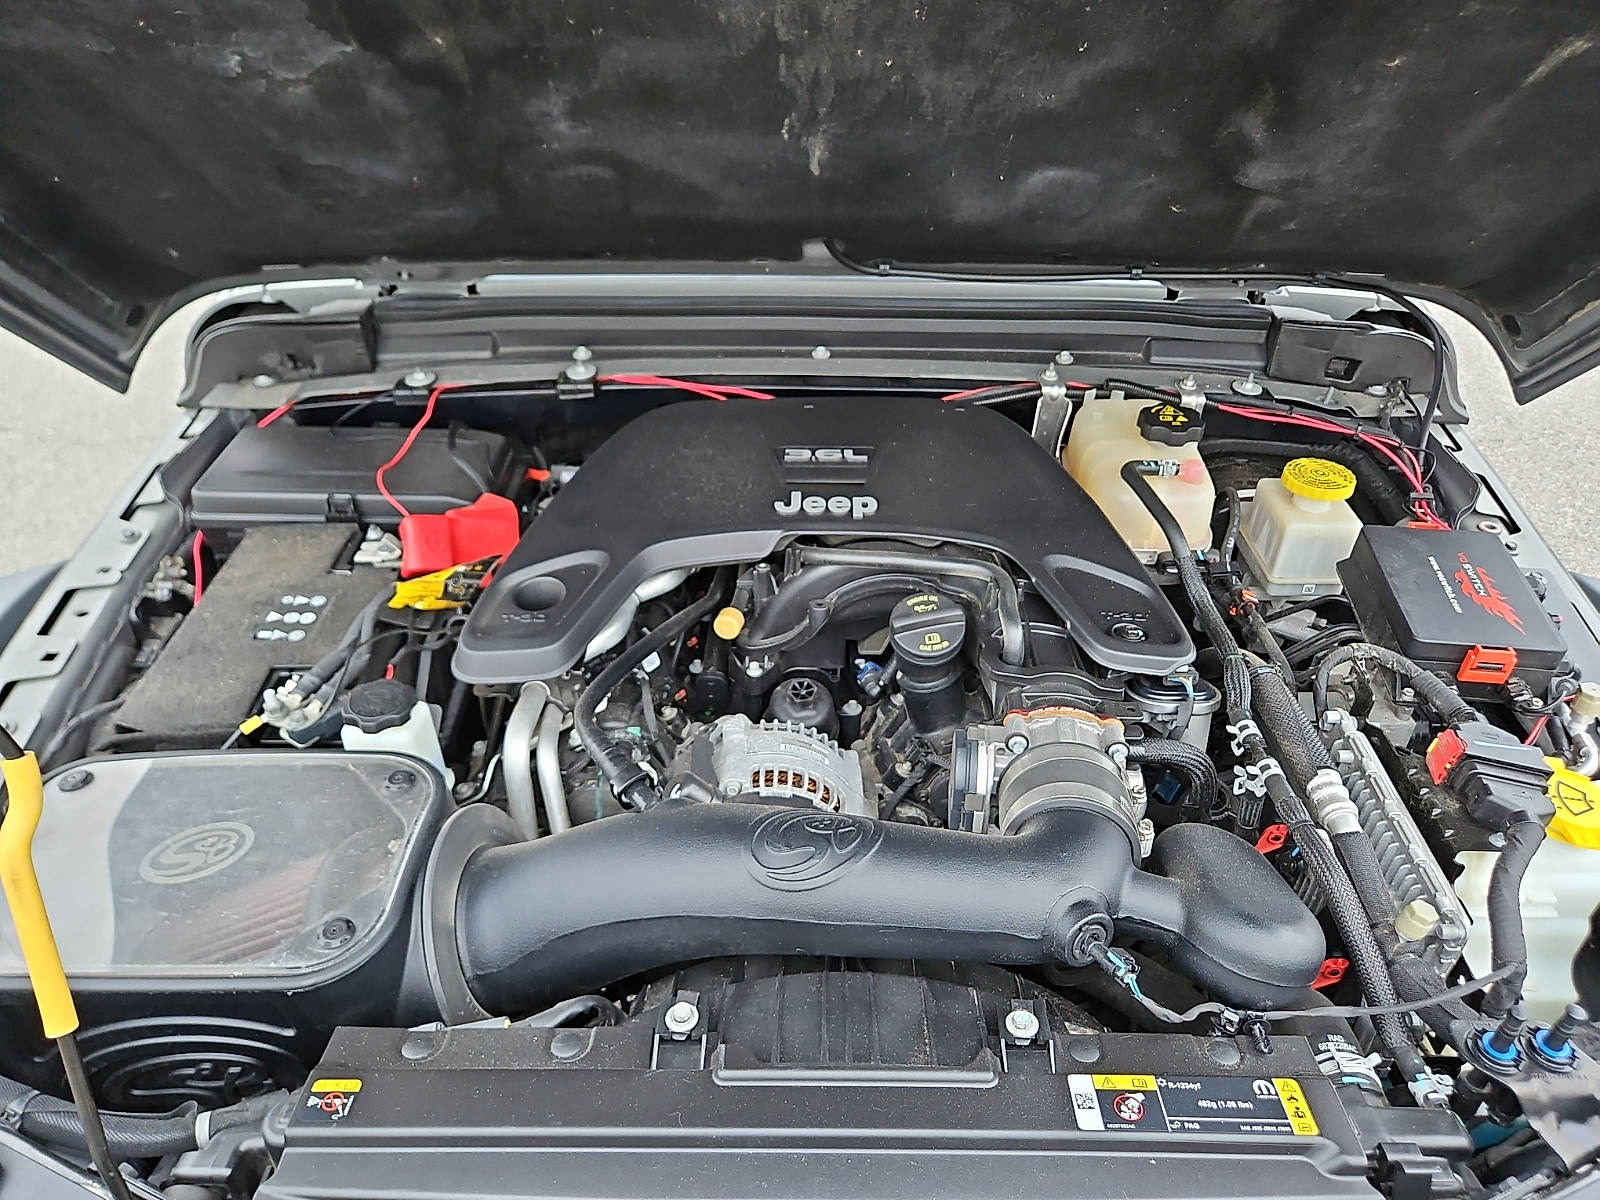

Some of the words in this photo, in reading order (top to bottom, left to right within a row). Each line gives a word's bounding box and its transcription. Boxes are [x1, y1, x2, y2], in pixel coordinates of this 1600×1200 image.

[783, 448, 869, 463] 3.6L
[773, 490, 879, 520] Jeep
[1327, 1034, 1345, 1042] RAD
